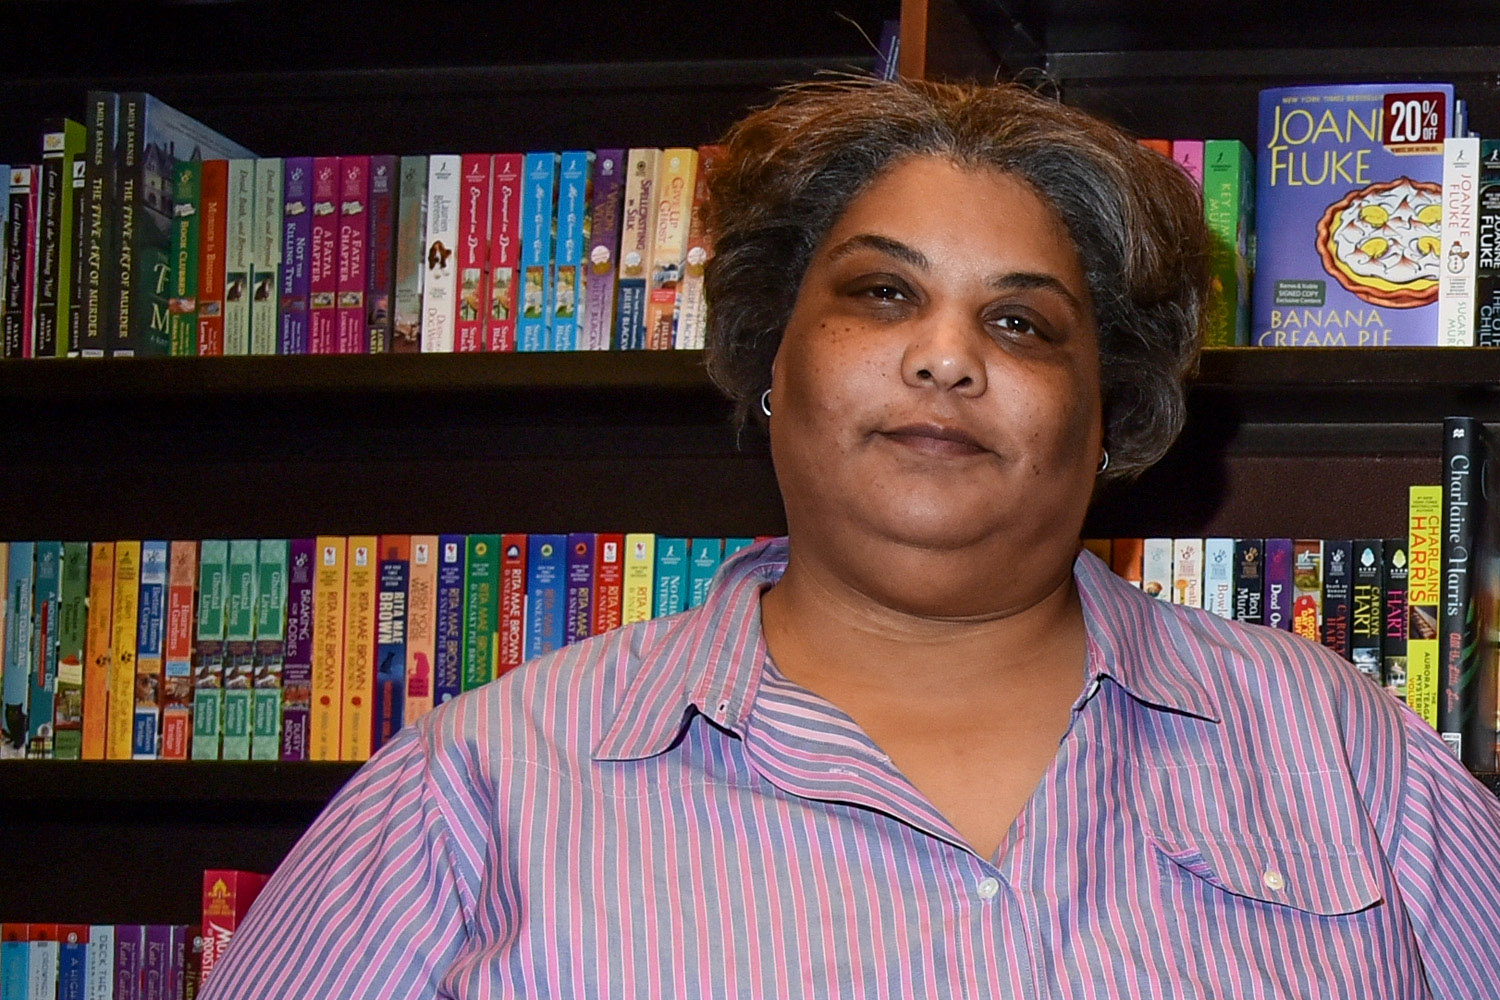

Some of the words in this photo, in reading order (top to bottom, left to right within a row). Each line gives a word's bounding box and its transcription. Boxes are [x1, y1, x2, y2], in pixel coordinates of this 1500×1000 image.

[1390, 100, 1438, 142] 20%
[1422, 128, 1438, 141] OFF
[1270, 145, 1372, 186] FLUKE
[124, 180, 133, 200] THE
[122, 204, 132, 240] FINE
[341, 226, 350, 282] CHAPTER
[352, 240, 361, 277] FATAL
[121, 272, 130, 286] OF
[120, 290, 130, 338] MURDER
[1271, 309, 1384, 329] BANANA
[1447, 454, 1470, 544] Charlaine
[1410, 516, 1426, 602] HARRIS
[1427, 515, 1439, 603] CHARLAINE
[1446, 545, 1468, 616] Harris
